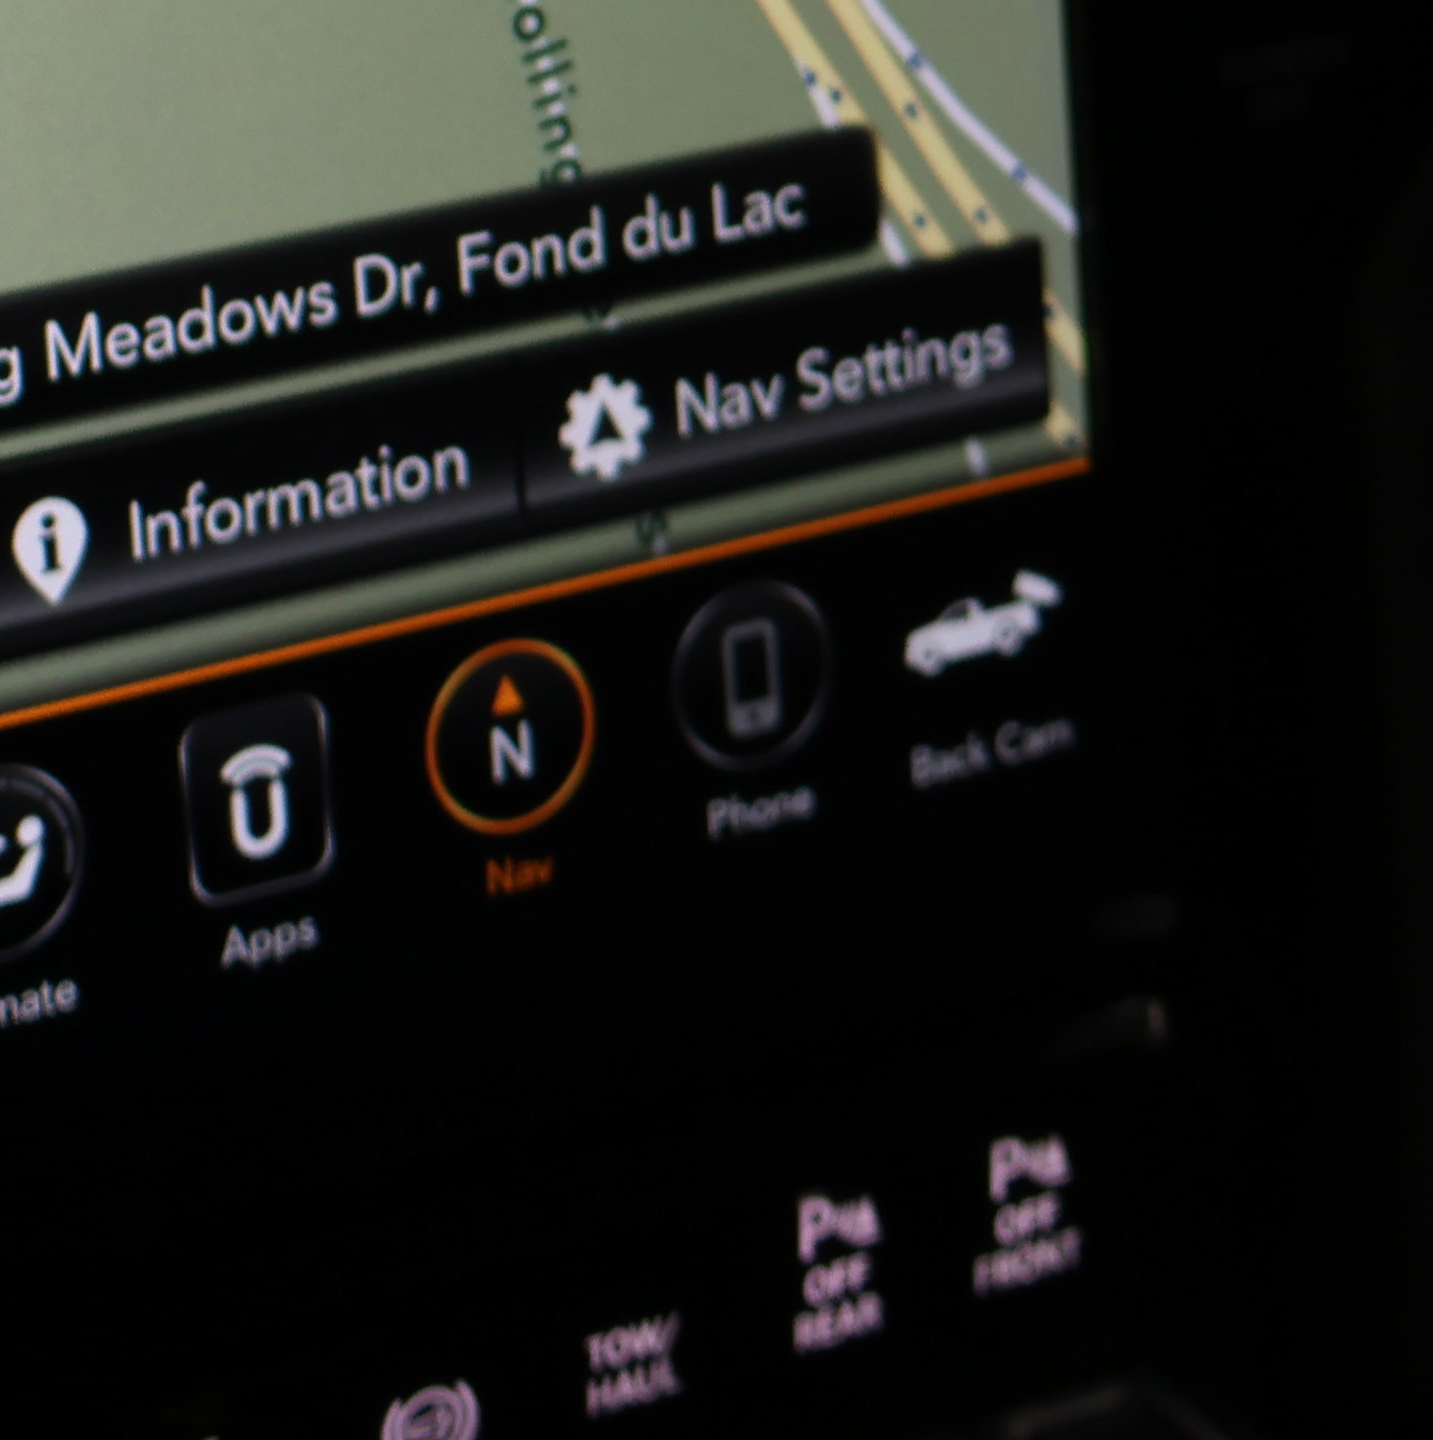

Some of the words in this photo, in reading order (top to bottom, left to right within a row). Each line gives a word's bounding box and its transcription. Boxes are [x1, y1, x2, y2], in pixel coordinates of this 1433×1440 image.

[43, 280, 336, 382] Meadows
[353, 253, 439, 317] Dr,
[457, 206, 606, 294] Fond
[622, 195, 695, 260] du
[711, 184, 804, 242] Lac
[675, 374, 783, 437] Nav
[797, 325, 1013, 412] Settings
[129, 445, 470, 558] Information
[910, 731, 987, 789] Back
[993, 716, 1076, 769] Cam
[707, 788, 815, 836] Phone
[486, 859, 552, 894] Nav
[222, 917, 319, 966] Apps
